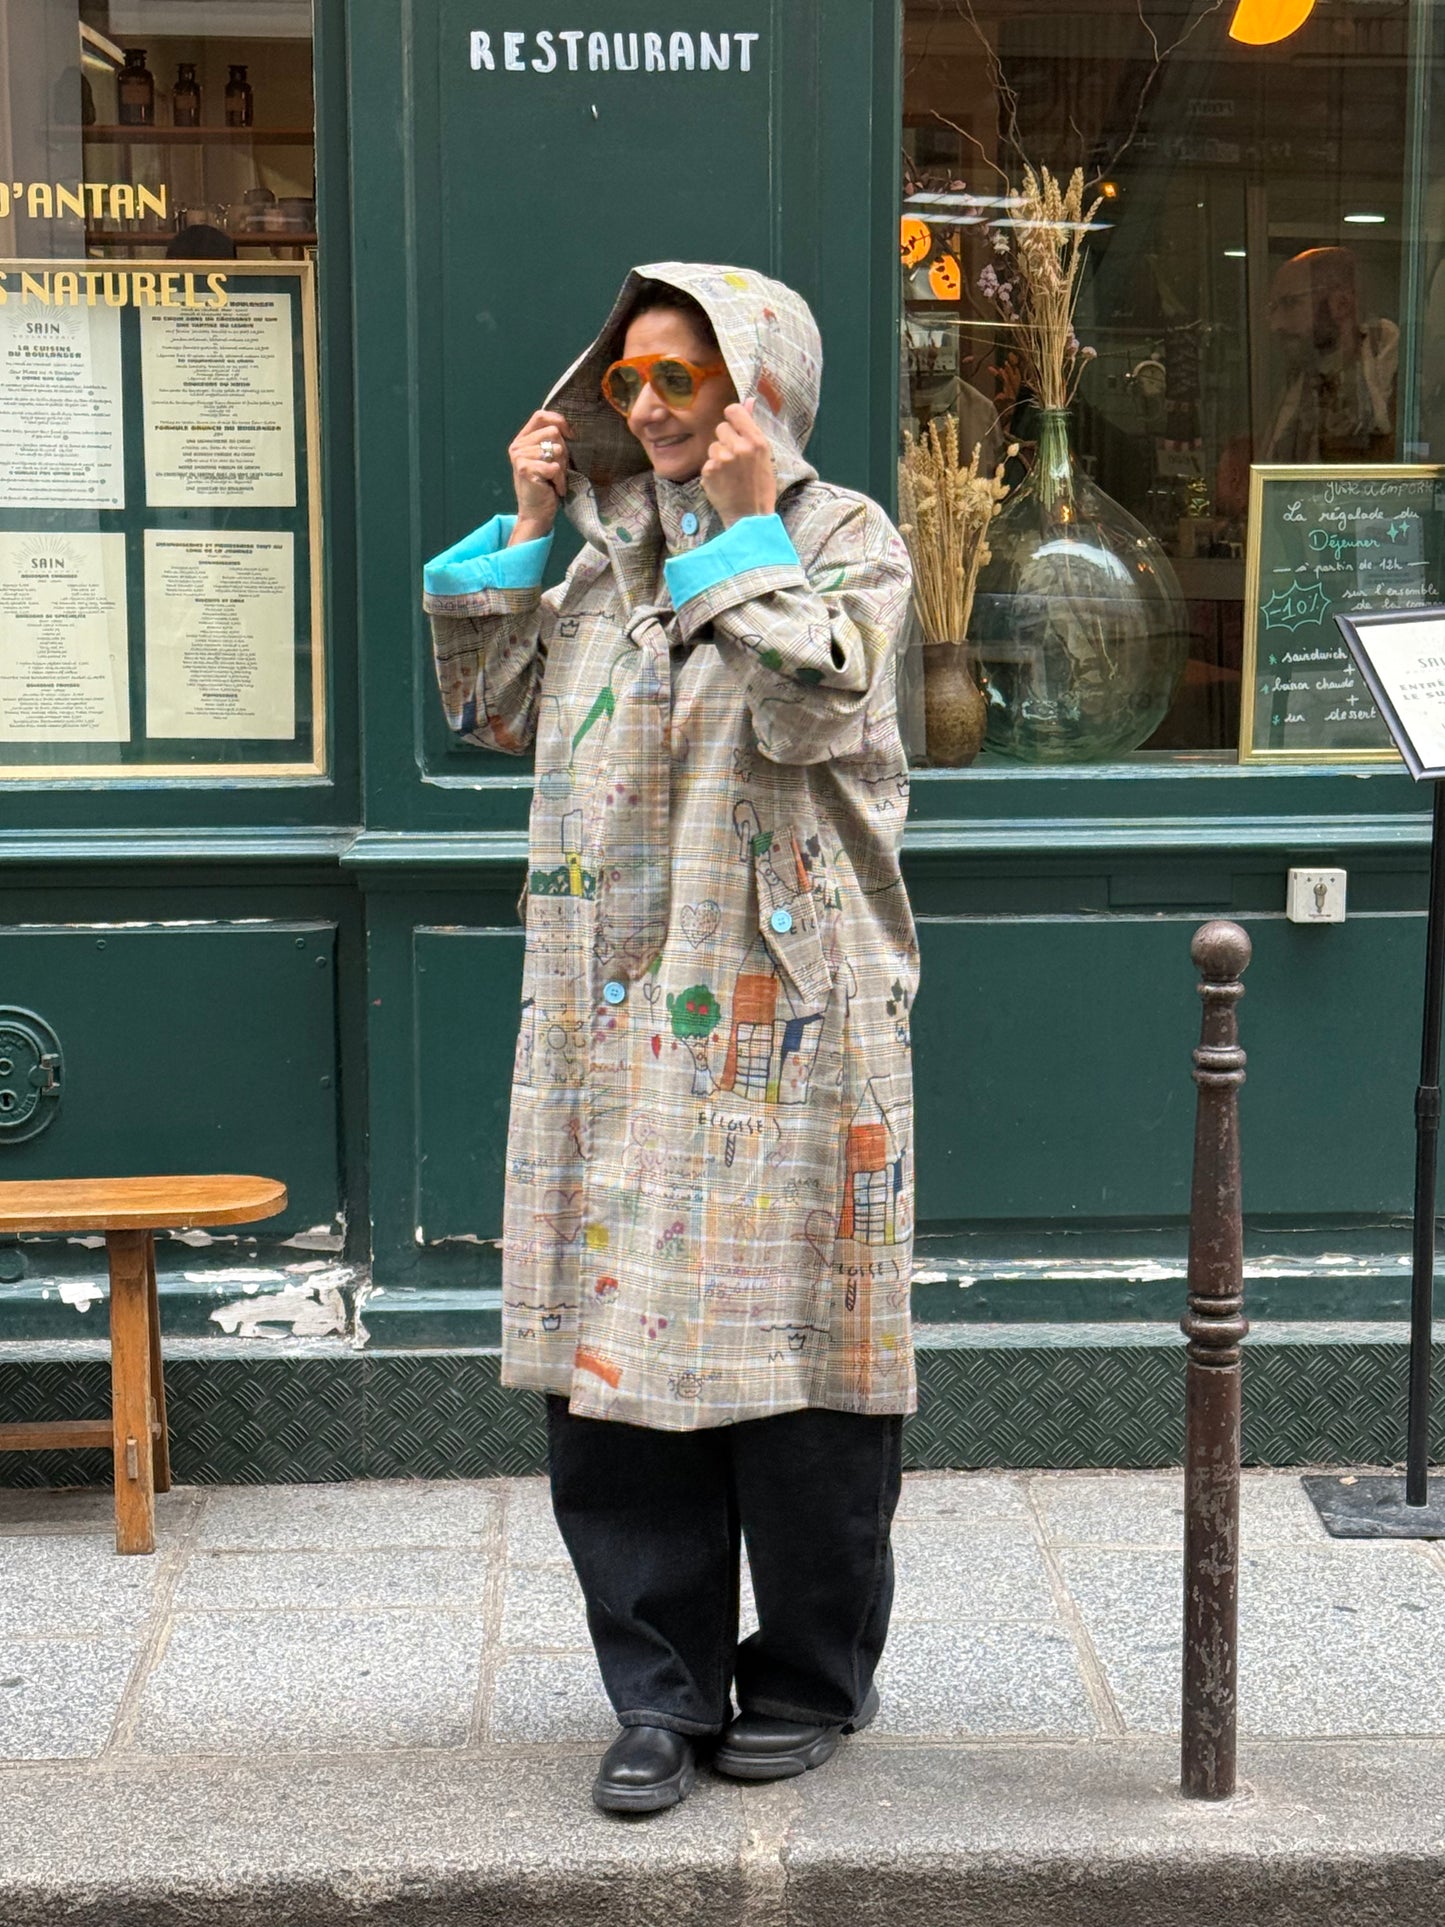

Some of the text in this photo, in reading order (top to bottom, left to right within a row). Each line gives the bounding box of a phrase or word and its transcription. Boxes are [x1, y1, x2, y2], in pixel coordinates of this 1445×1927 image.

[469, 30, 759, 73] RESTAURANT
[21, 271, 229, 307] NATURELS
[26, 322, 60, 334] SAIN
[1283, 500, 1420, 531] La régalade du
[1308, 529, 1380, 560] Déjeuner
[31, 558, 65, 569] SAIN
[1313, 561, 1354, 579] partir
[1358, 559, 1372, 571] de
[1379, 557, 1403, 571] 12h
[1342, 583, 1440, 598] sur l'ensemble
[1351, 600, 1373, 612] de
[1381, 599, 1401, 611] la
[1282, 647, 1348, 663] sandwich
[1315, 677, 1355, 690] chaude
[1284, 707, 1377, 722] un dessert
